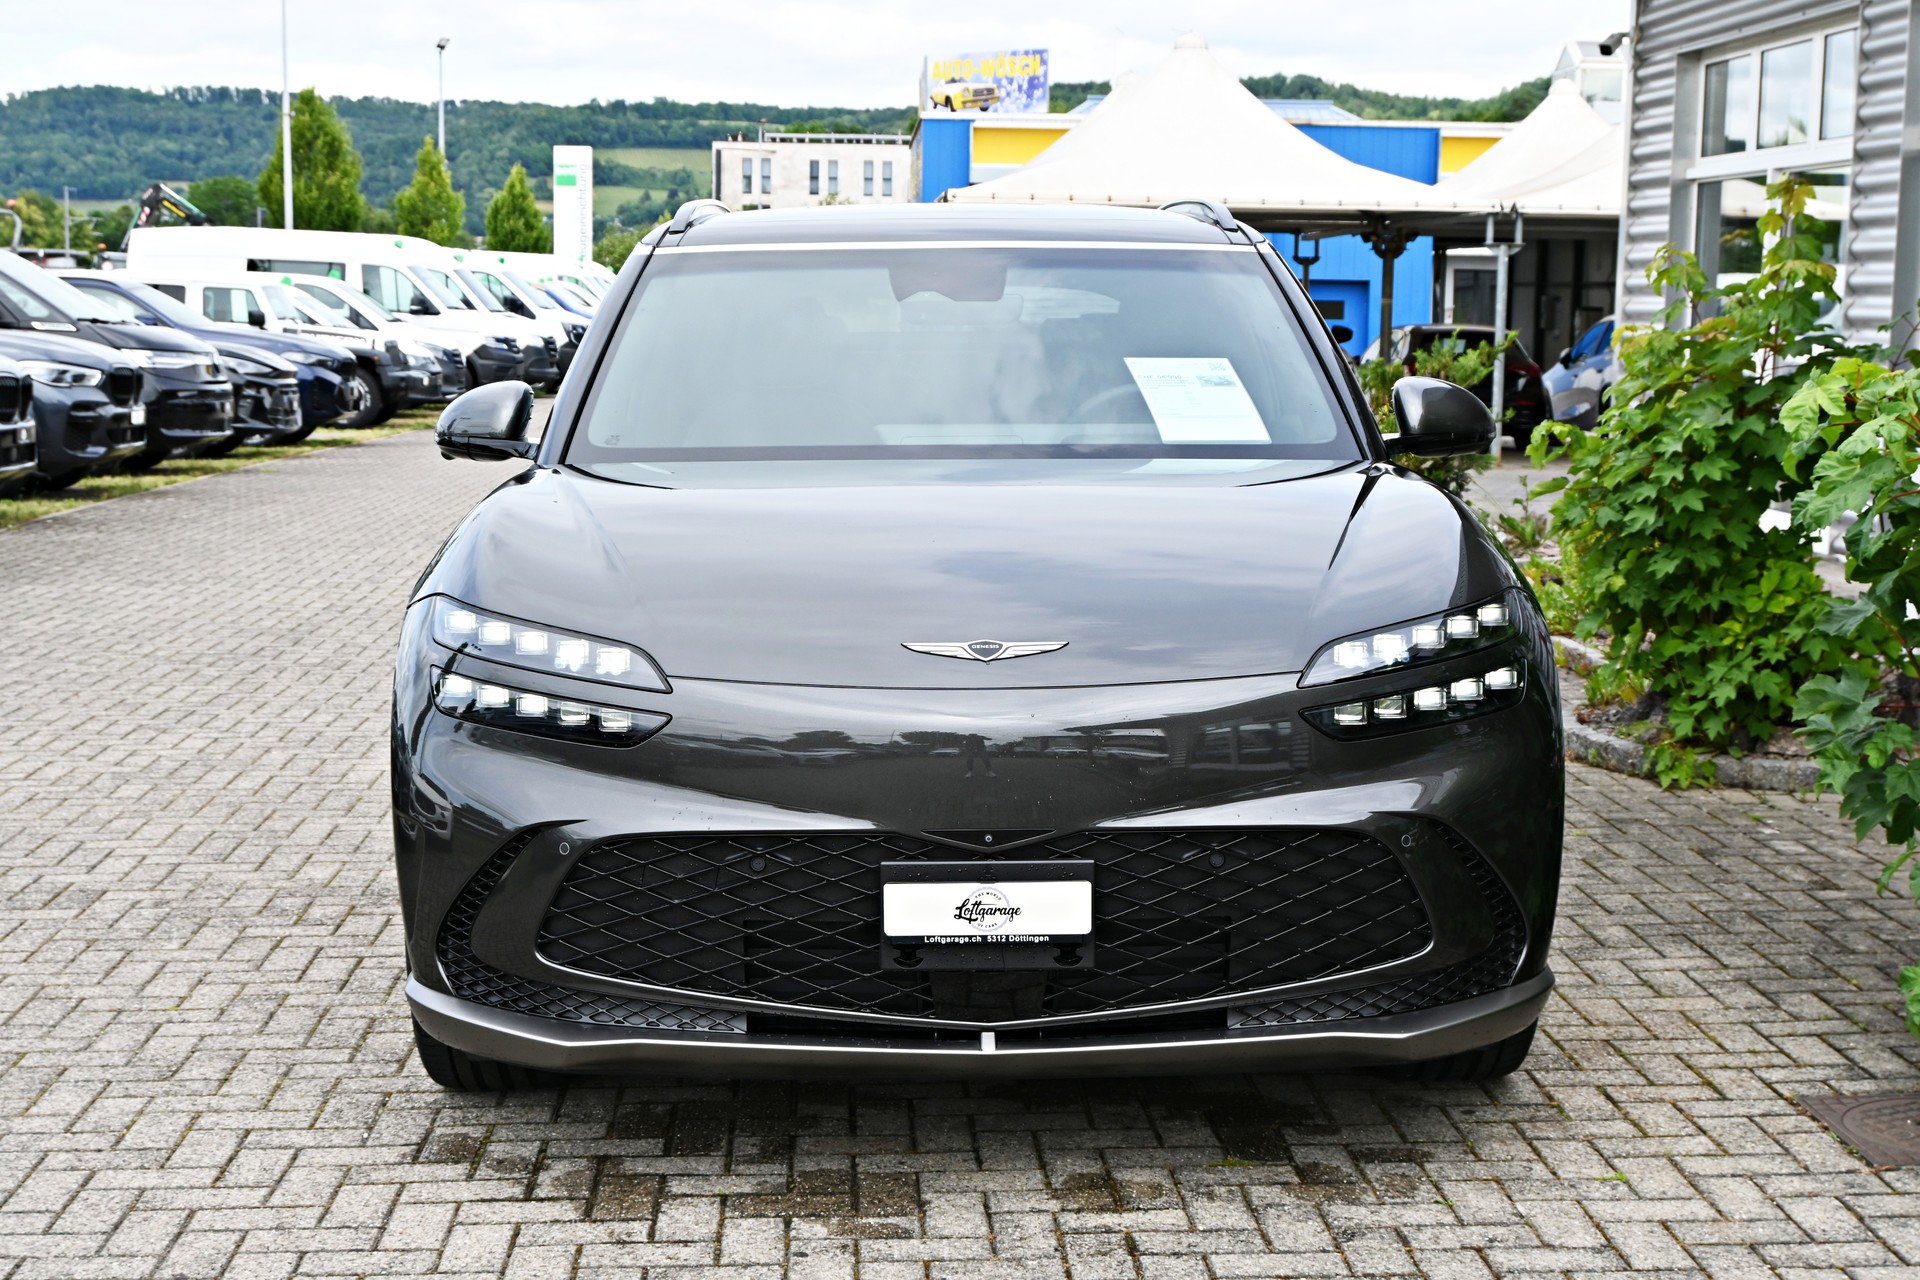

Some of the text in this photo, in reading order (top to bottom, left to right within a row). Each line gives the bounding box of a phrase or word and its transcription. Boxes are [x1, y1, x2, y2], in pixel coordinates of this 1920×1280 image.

[932, 52, 1041, 80] AUTO-WÖSCH
[579, 164, 590, 257] eugeinrichtung
[986, 892, 1002, 901] WORLD
[954, 898, 1022, 924] Loftgarage
[924, 935, 982, 944] Loftgarage.ch
[1008, 935, 1049, 943] Döttingen
